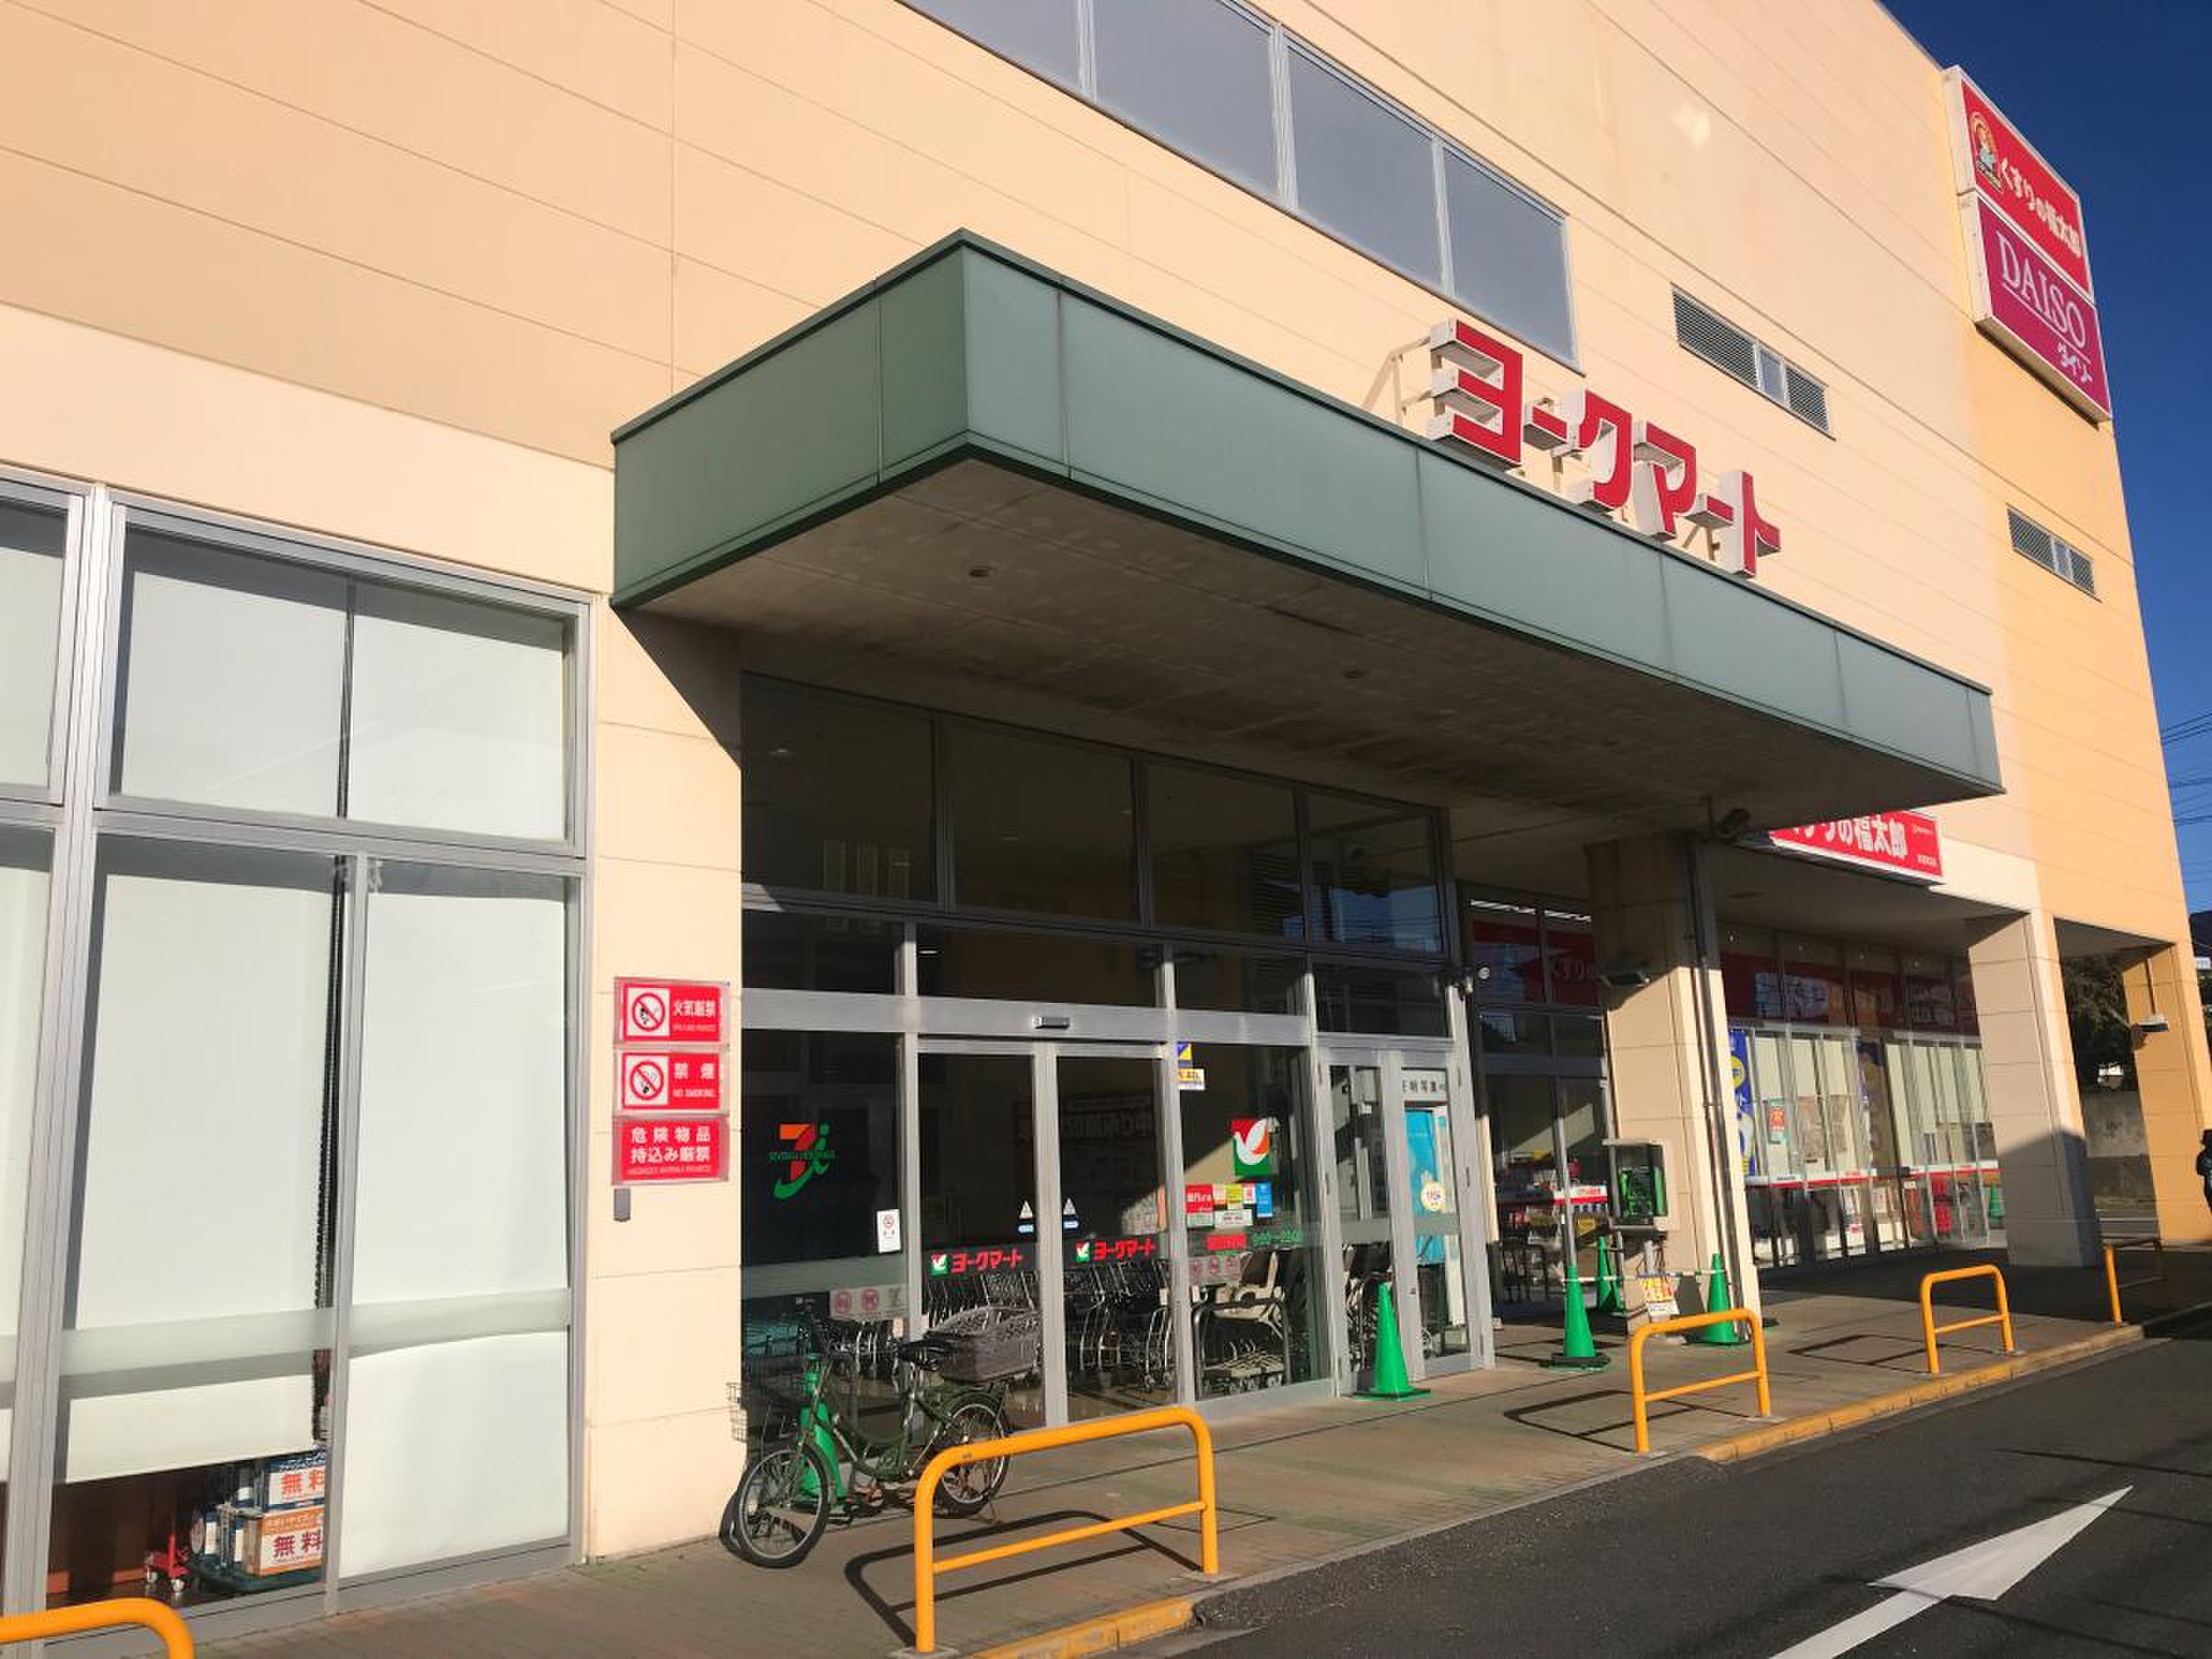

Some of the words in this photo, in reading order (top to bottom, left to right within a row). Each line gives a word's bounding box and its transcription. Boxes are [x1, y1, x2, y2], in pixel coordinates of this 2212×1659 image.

[1995, 229, 2087, 349] DAISO
[1442, 317, 1782, 577] ヨークマート
[951, 1249, 1023, 1274] ヨークマート
[1092, 1238, 1157, 1261] ヨークマート
[273, 1529, 324, 1557] 無料
